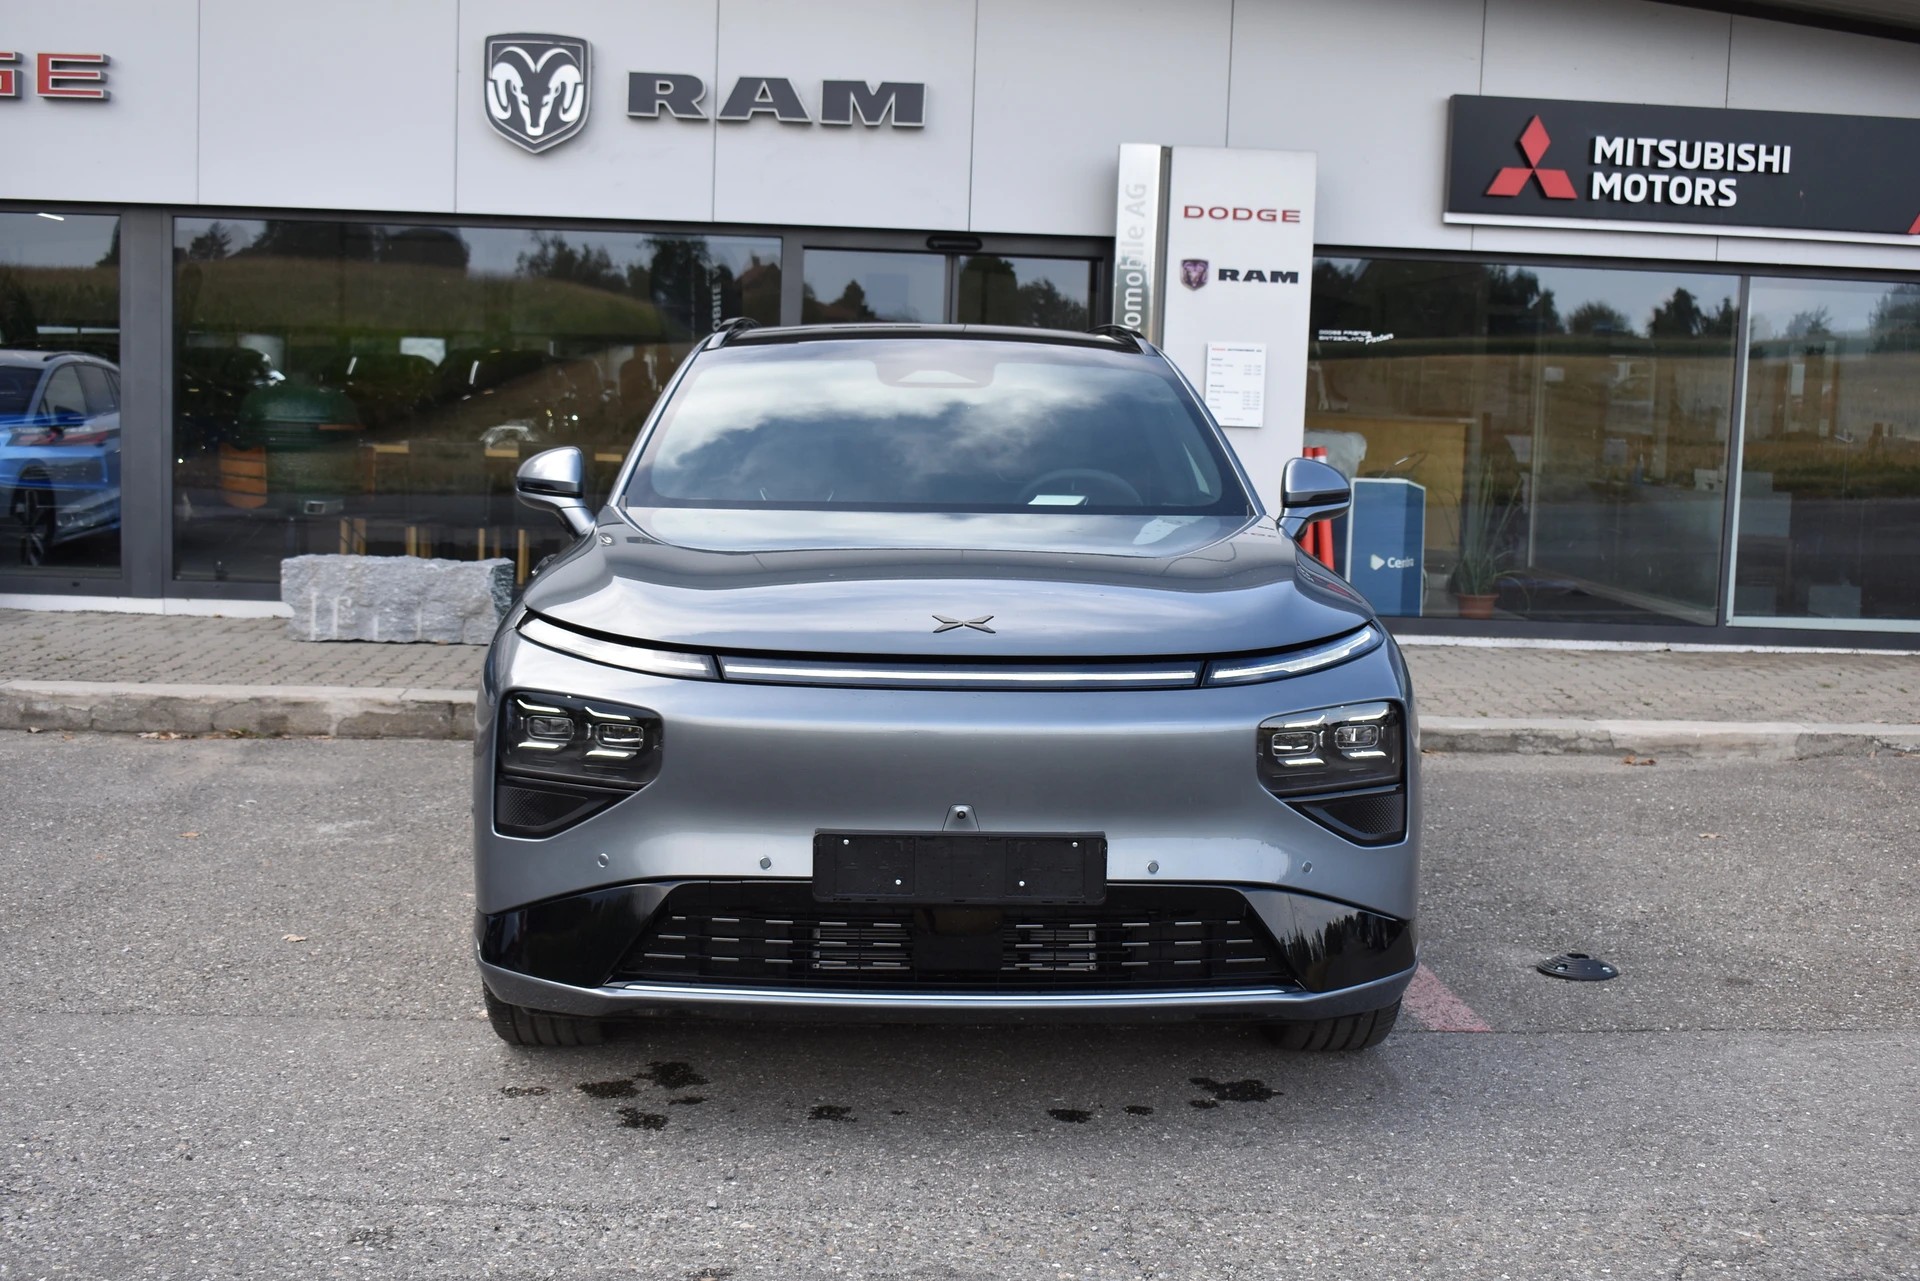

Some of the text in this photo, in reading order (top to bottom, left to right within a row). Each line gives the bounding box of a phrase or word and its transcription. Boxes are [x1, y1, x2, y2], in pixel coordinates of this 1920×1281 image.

[627, 70, 927, 128] RAM
[1593, 135, 1791, 174] MITSUBISHI
[1591, 172, 1737, 208] MOTORS
[1183, 205, 1301, 223] DODGE
[1119, 183, 1147, 331] omobile AG
[1218, 268, 1299, 284] RAM
